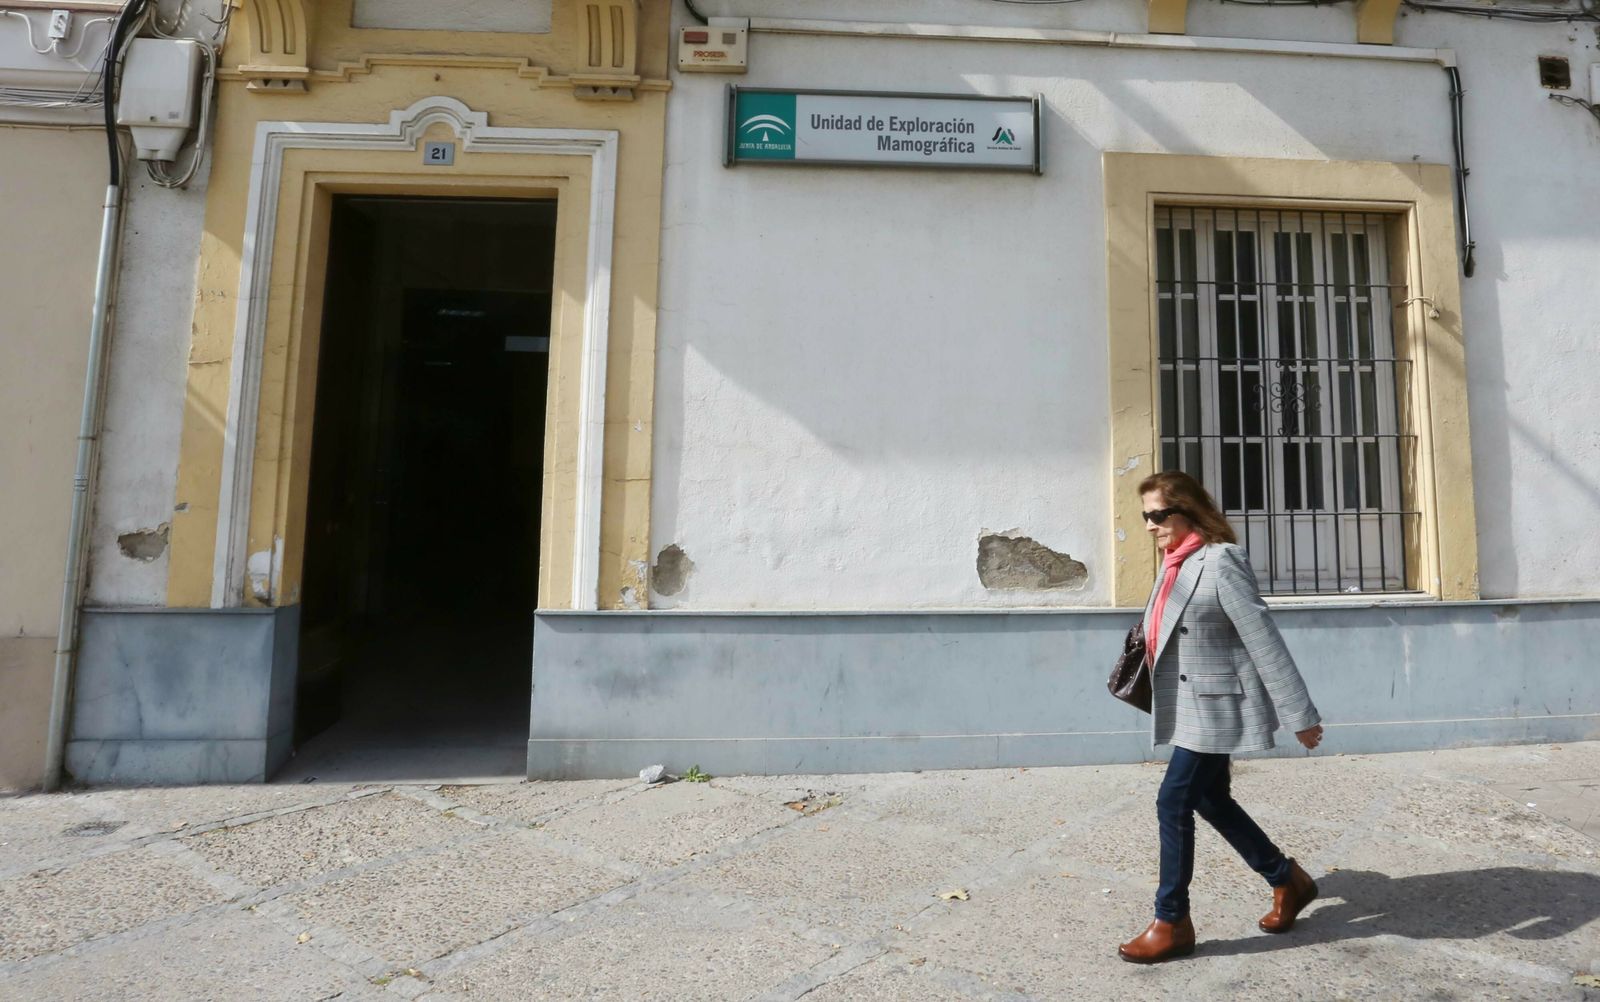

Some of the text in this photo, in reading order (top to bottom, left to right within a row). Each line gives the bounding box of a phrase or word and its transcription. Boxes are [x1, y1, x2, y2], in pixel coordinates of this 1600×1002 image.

[811, 114, 975, 135] Unidad de Exploración
[431, 147, 446, 160] 21
[877, 135, 975, 156] Mamográfica
